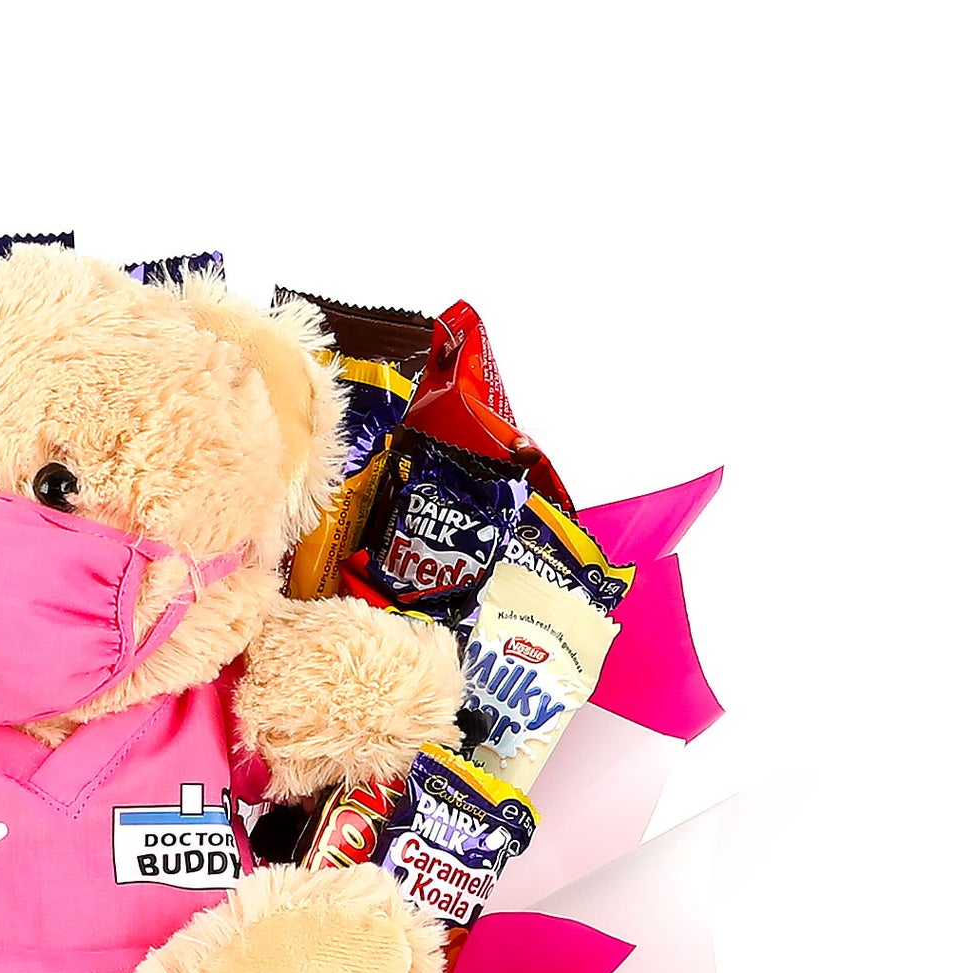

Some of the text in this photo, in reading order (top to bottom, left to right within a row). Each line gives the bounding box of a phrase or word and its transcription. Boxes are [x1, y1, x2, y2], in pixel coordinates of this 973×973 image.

[405, 514, 458, 547] MILK
[408, 494, 481, 531] DAIRY
[417, 792, 489, 838] DAIRY
[424, 775, 487, 821] Cadbury
[144, 832, 235, 848] DOCTOR
[410, 812, 465, 856] MILK
[136, 850, 242, 880] BUDDY
[409, 873, 469, 920] Koala
